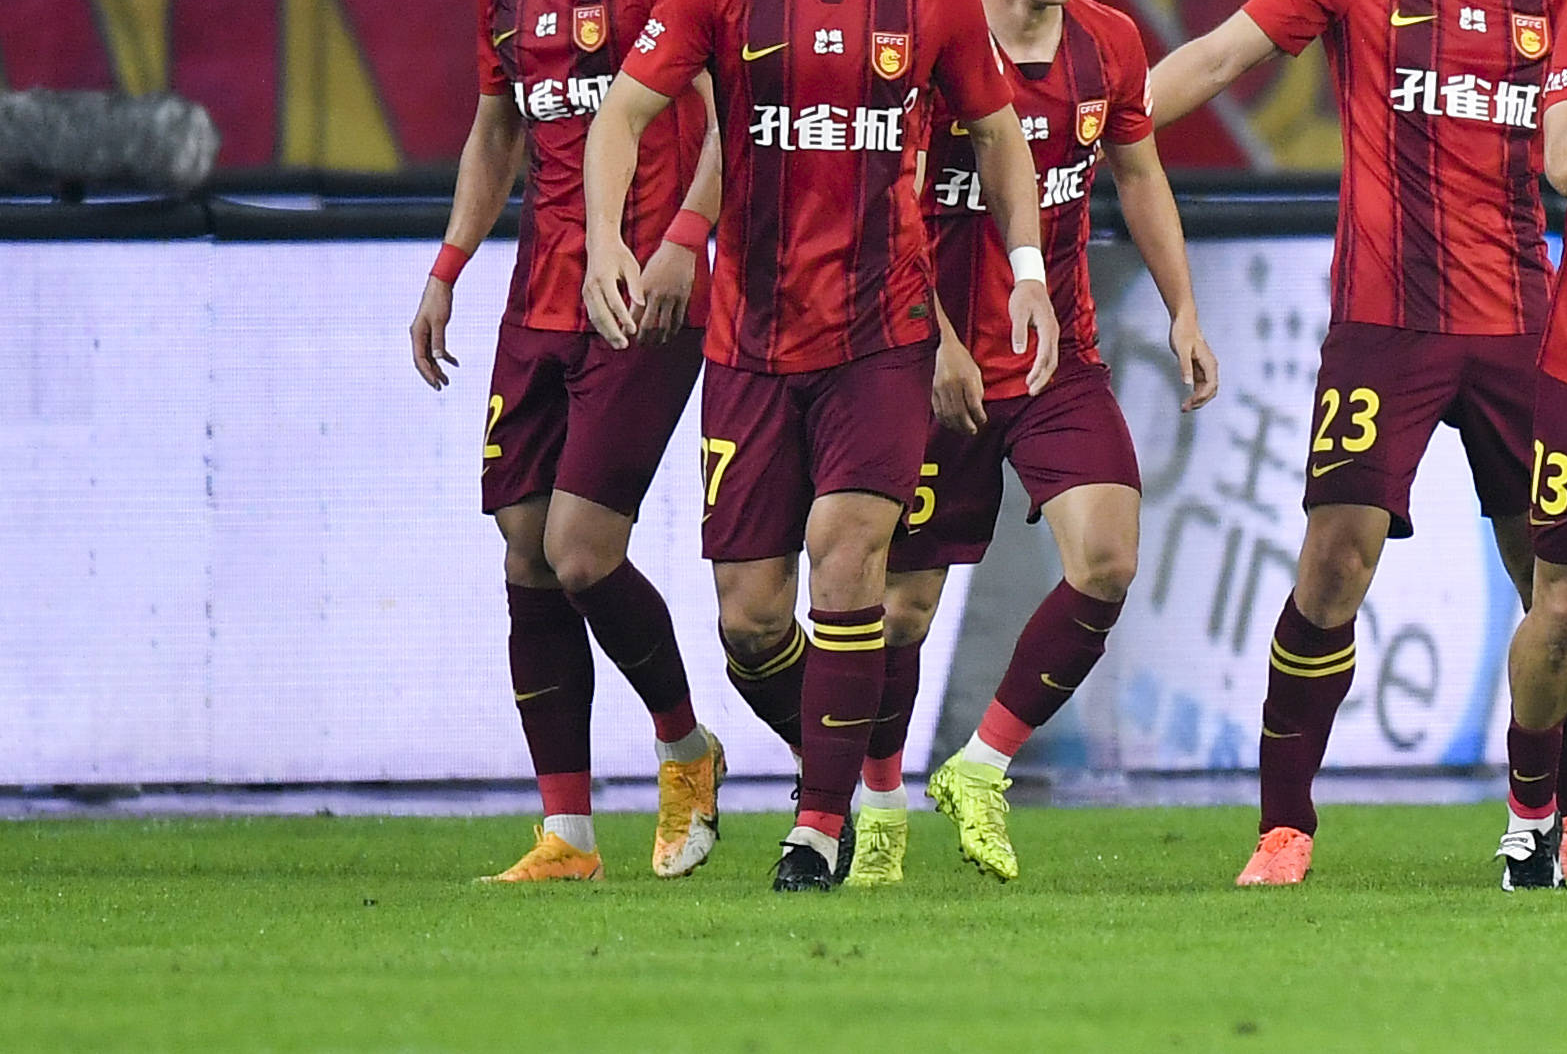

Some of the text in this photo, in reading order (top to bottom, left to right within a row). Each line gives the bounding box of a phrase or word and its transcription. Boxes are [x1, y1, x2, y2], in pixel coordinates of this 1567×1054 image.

[749, 103, 904, 152] 孔雀城
[1390, 67, 1541, 130] 孔雀城
[1312, 387, 1381, 453] 23
